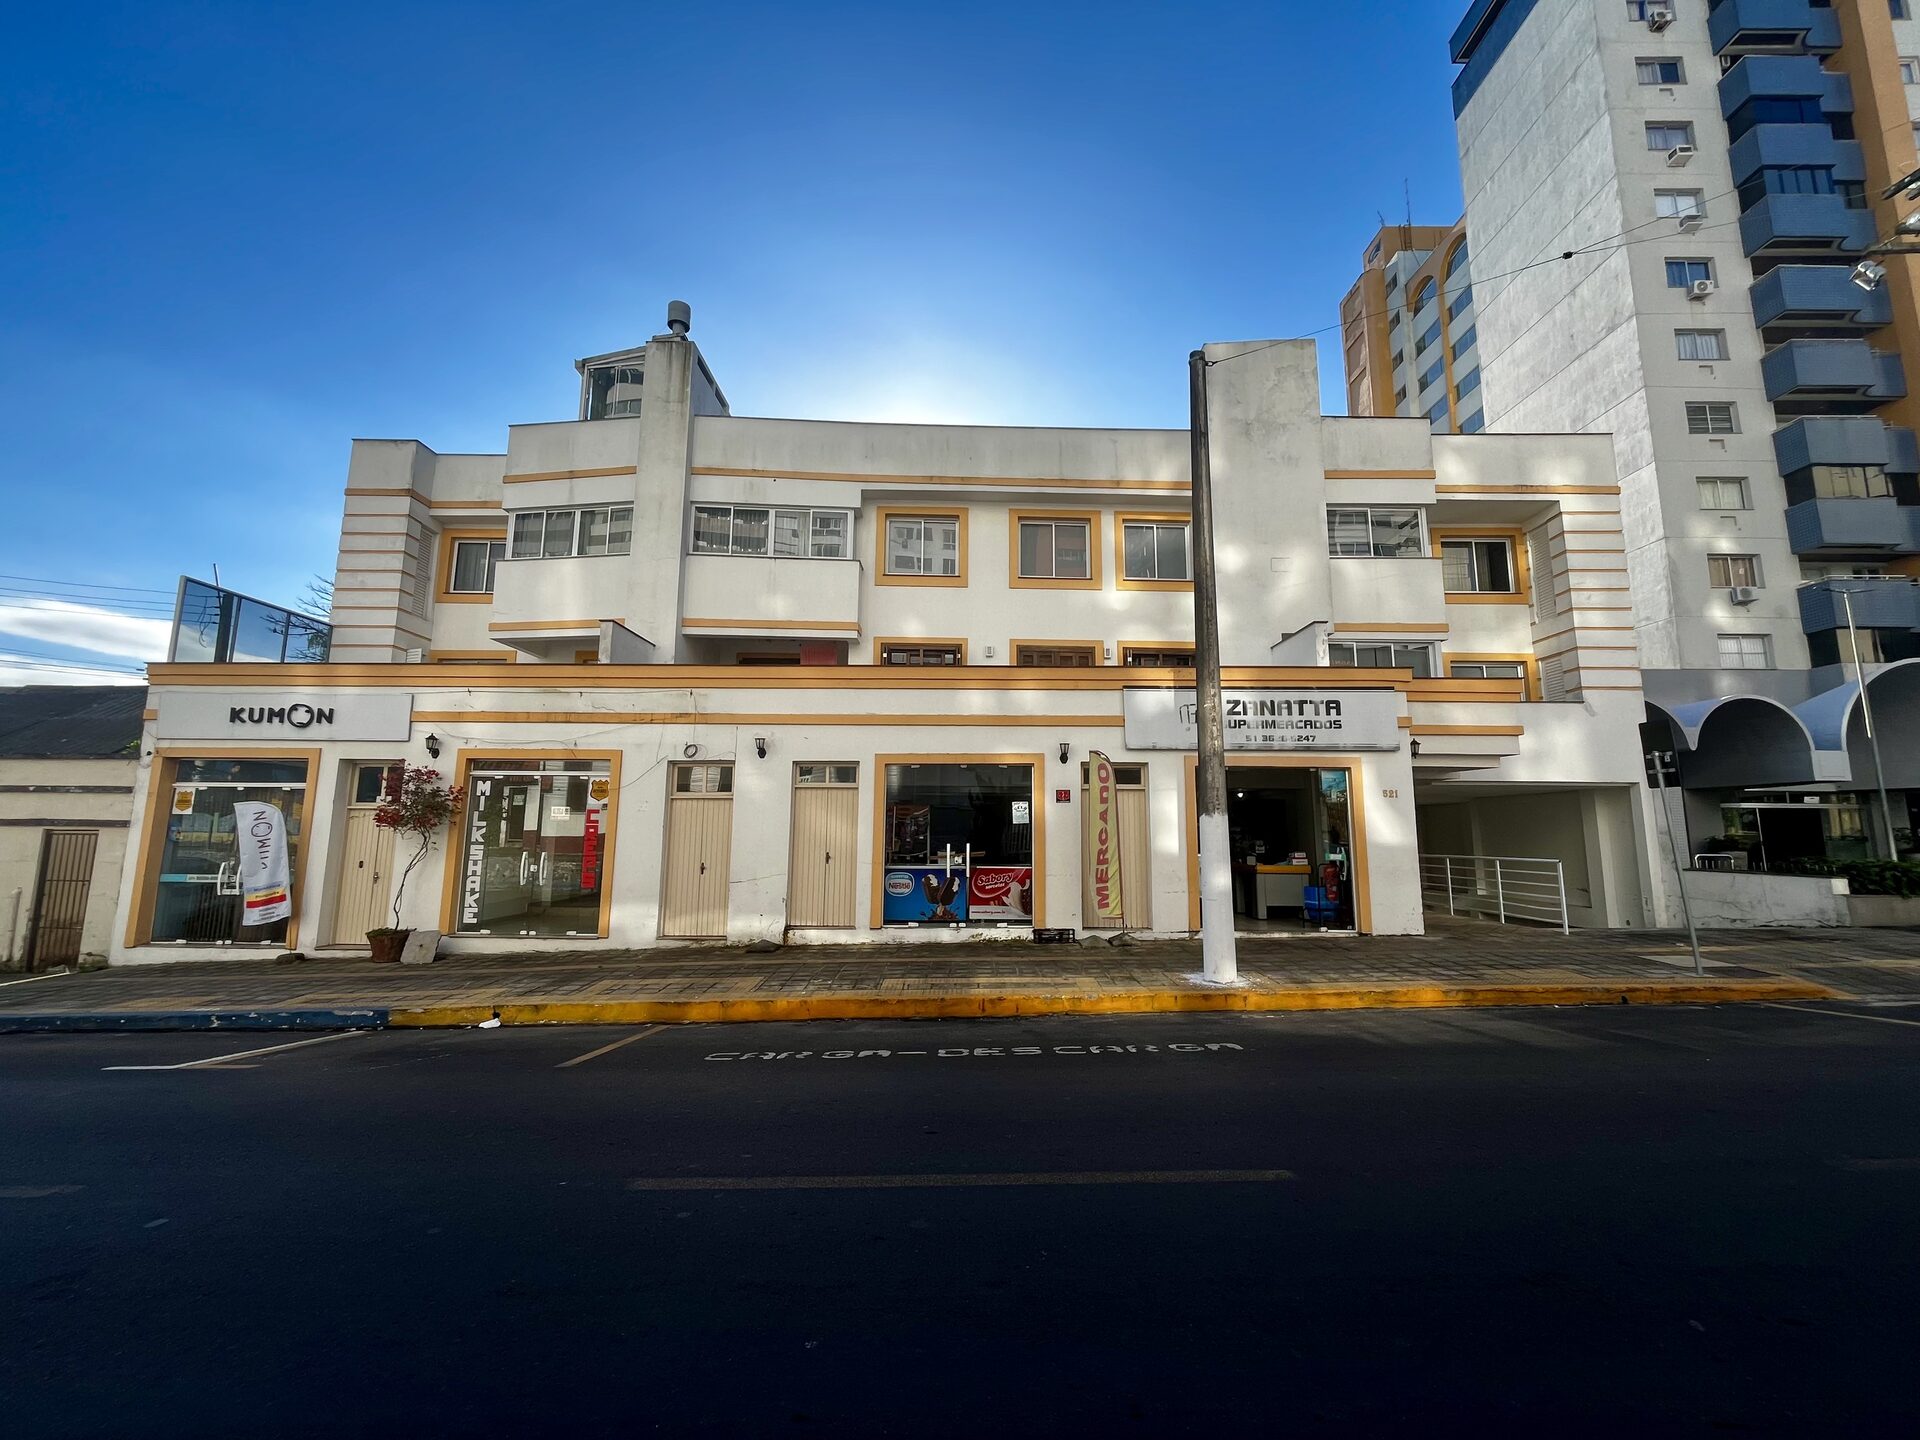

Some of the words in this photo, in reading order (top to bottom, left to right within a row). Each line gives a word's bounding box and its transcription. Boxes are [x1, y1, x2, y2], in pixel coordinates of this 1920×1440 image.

[229, 703, 334, 727] KUMON
[1226, 699, 1342, 716] ZANATTA
[1223, 719, 1342, 730] UPERMERCADOS
[1382, 789, 1399, 799] 521
[1097, 762, 1111, 910] MERCADO
[462, 780, 491, 924] MILKSHAKE
[977, 872, 1014, 887] Sabory
